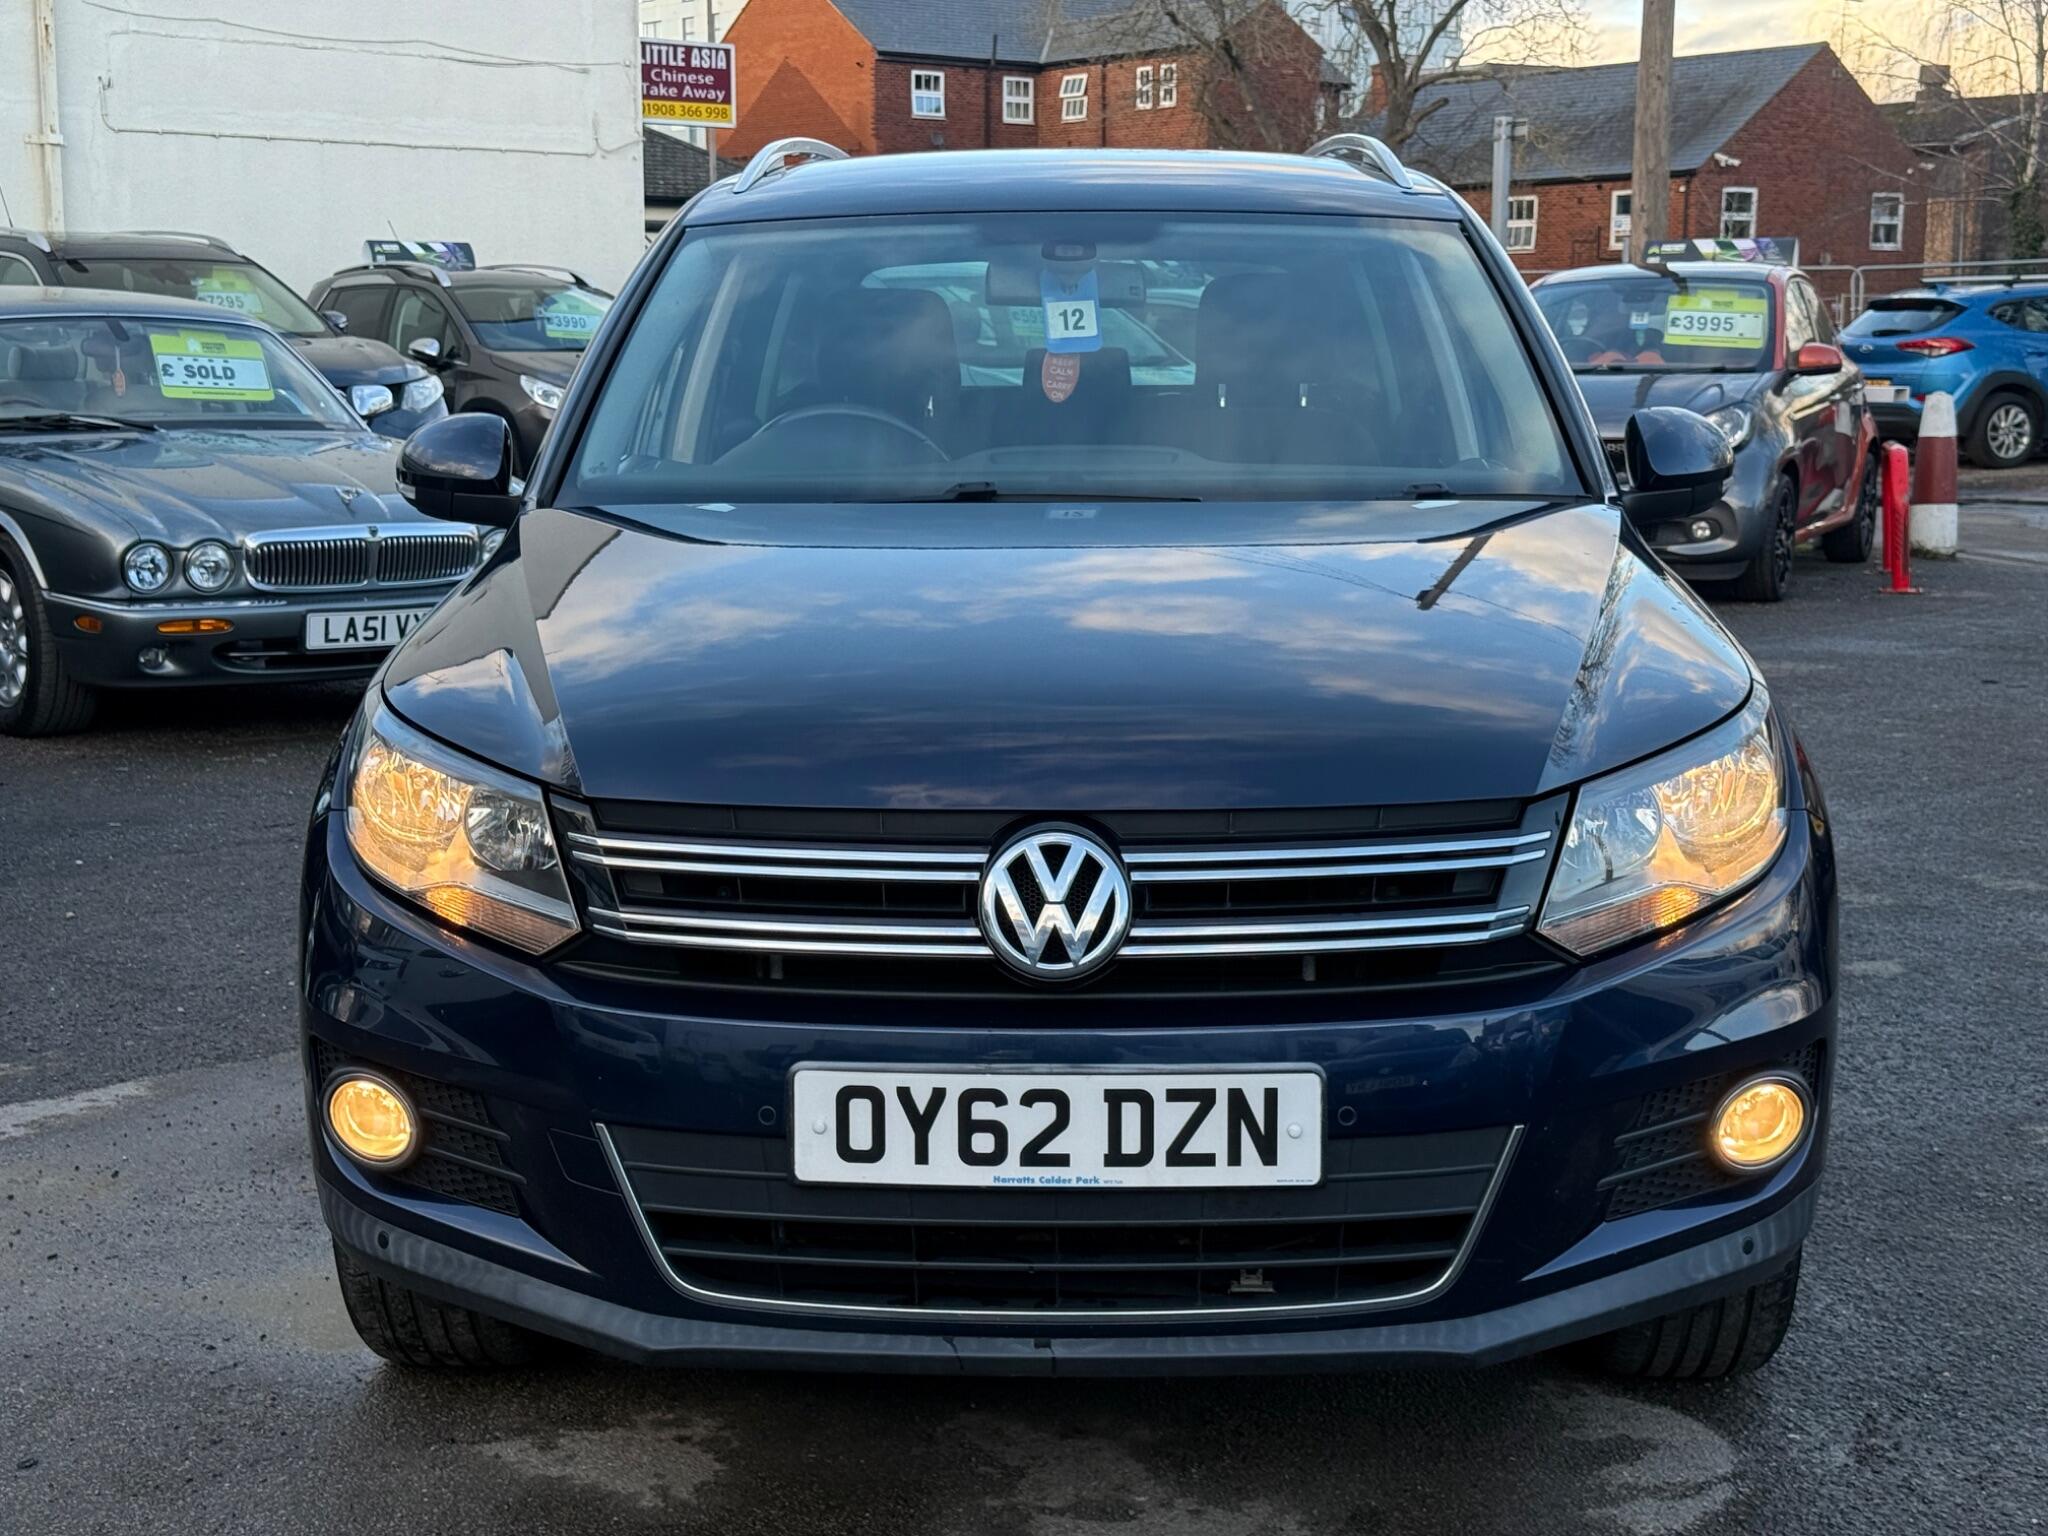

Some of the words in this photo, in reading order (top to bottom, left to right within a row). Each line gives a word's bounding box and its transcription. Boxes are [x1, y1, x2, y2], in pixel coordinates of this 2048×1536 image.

[690, 46, 728, 70] ASIA
[650, 67, 715, 86] Chinese
[642, 82, 678, 97] Take
[682, 84, 726, 103] Away
[679, 104, 702, 118] 366
[705, 106, 729, 120] 998
[1058, 307, 1086, 331] 12
[1669, 315, 1735, 332] £3995
[161, 363, 175, 377] £
[183, 364, 236, 380] SOLD
[324, 614, 387, 644] LA51
[835, 1084, 1071, 1168] OY62
[1103, 1087, 1279, 1168] DZN
[993, 1175, 1035, 1184] Harratts
[1039, 1175, 1072, 1184] Calder
[1076, 1175, 1100, 1184] Park
